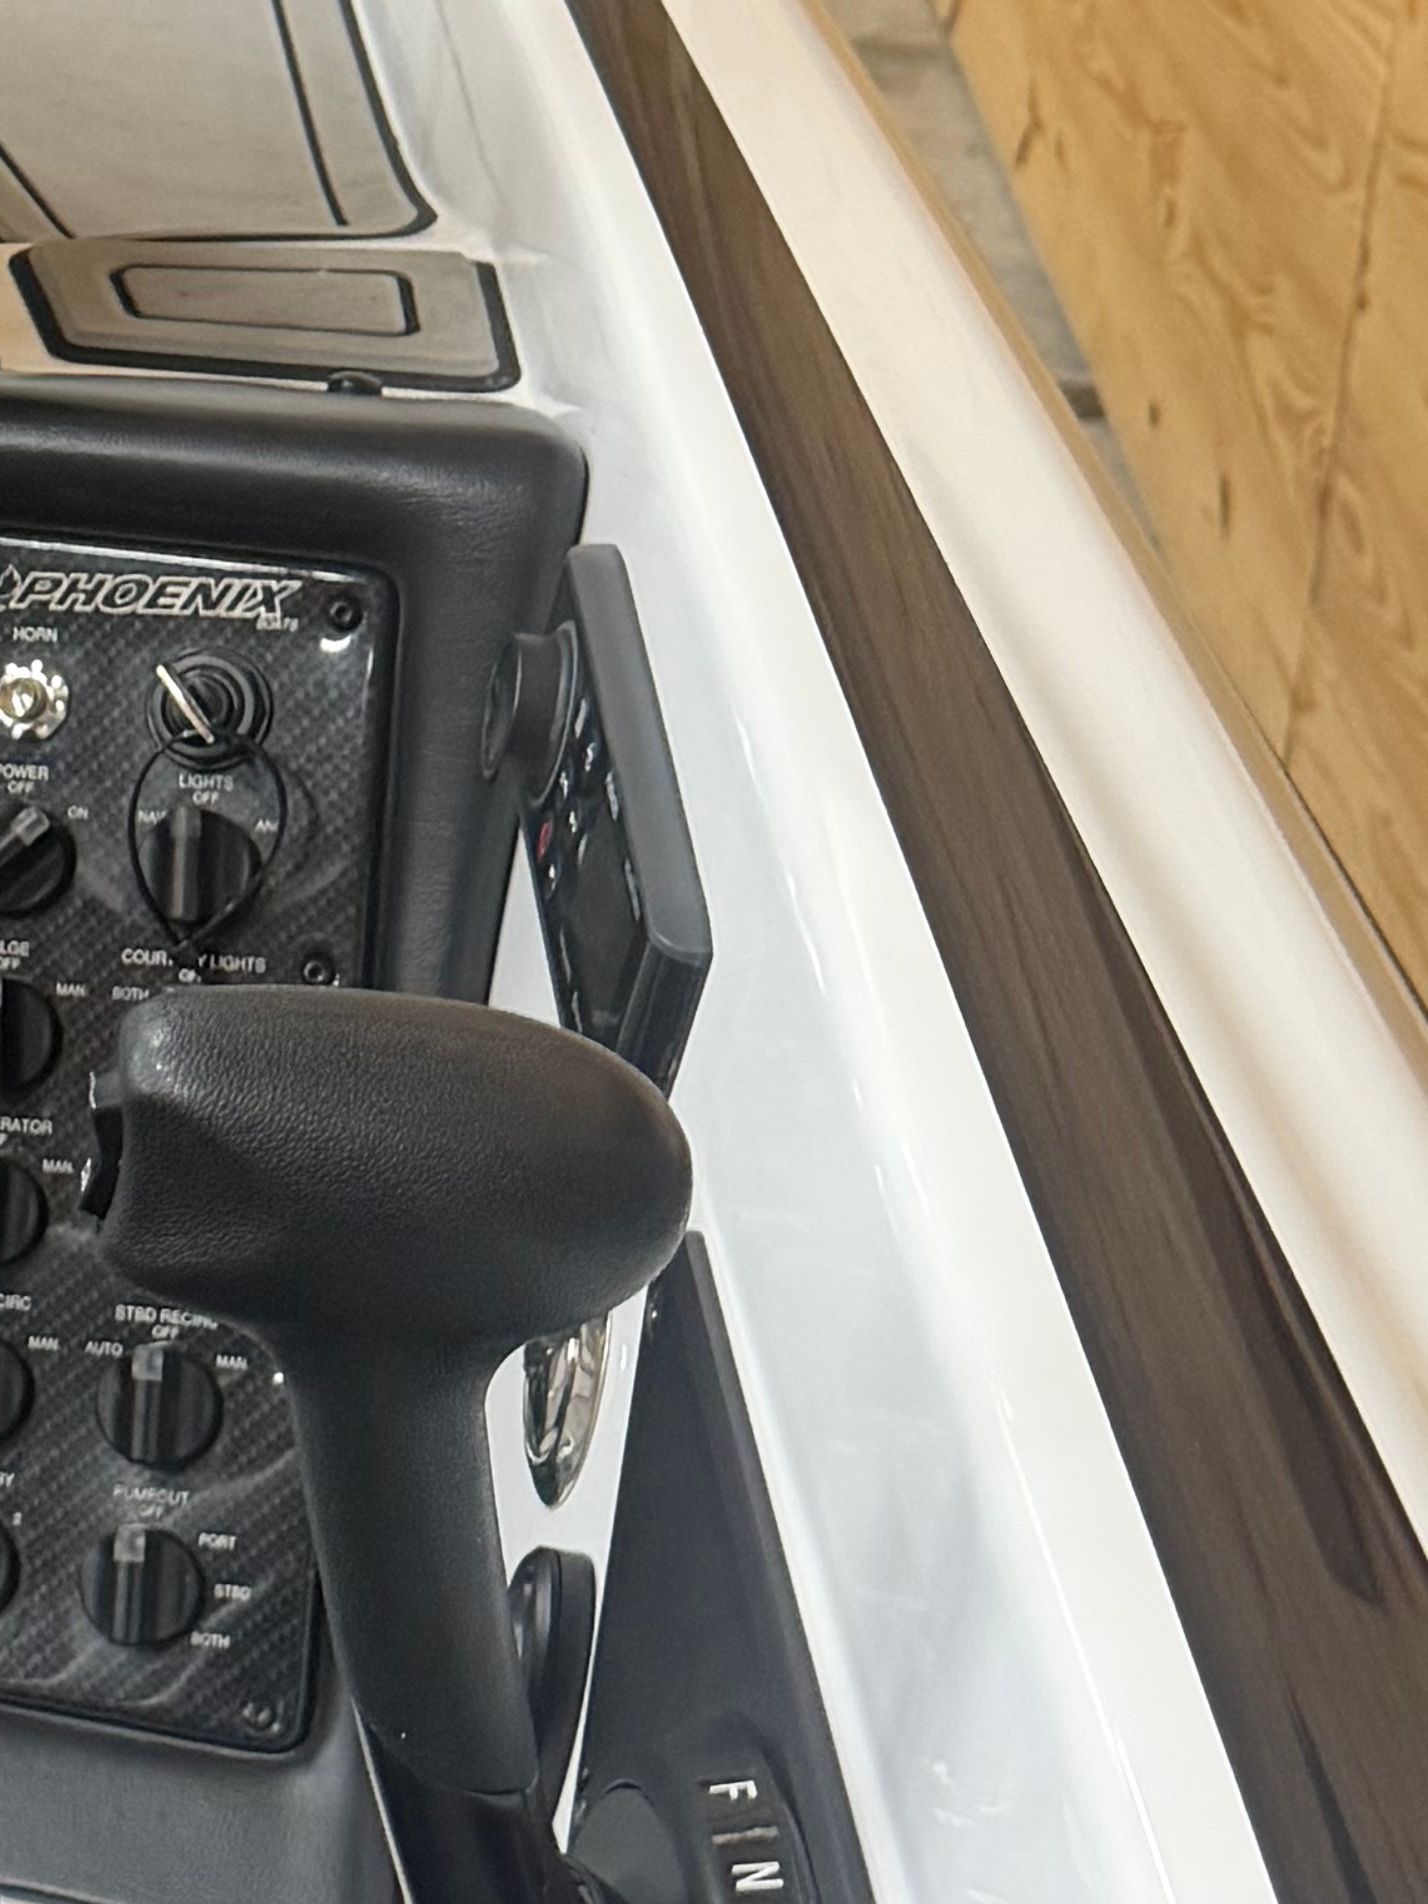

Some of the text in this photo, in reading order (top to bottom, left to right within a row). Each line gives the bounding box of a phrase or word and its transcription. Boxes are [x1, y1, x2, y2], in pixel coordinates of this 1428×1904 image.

[8, 570, 303, 620] PHOENIX
[11, 625, 58, 643] HORN
[6, 779, 36, 795] OFF
[177, 772, 235, 793] LIGHTS
[191, 790, 220, 806] OFF
[66, 803, 90, 821] ON
[209, 952, 267, 974] LIGHTS
[55, 980, 87, 998] MAN
[114, 1303, 157, 1325] STBD
[151, 1324, 180, 1341] OFF
[27, 1335, 61, 1353] MAN
[84, 1340, 124, 1357] AUTO
[215, 1353, 249, 1371] MAN
[198, 1532, 238, 1551] PORT
[708, 1779, 758, 1801] F
[730, 1860, 785, 1893] N
